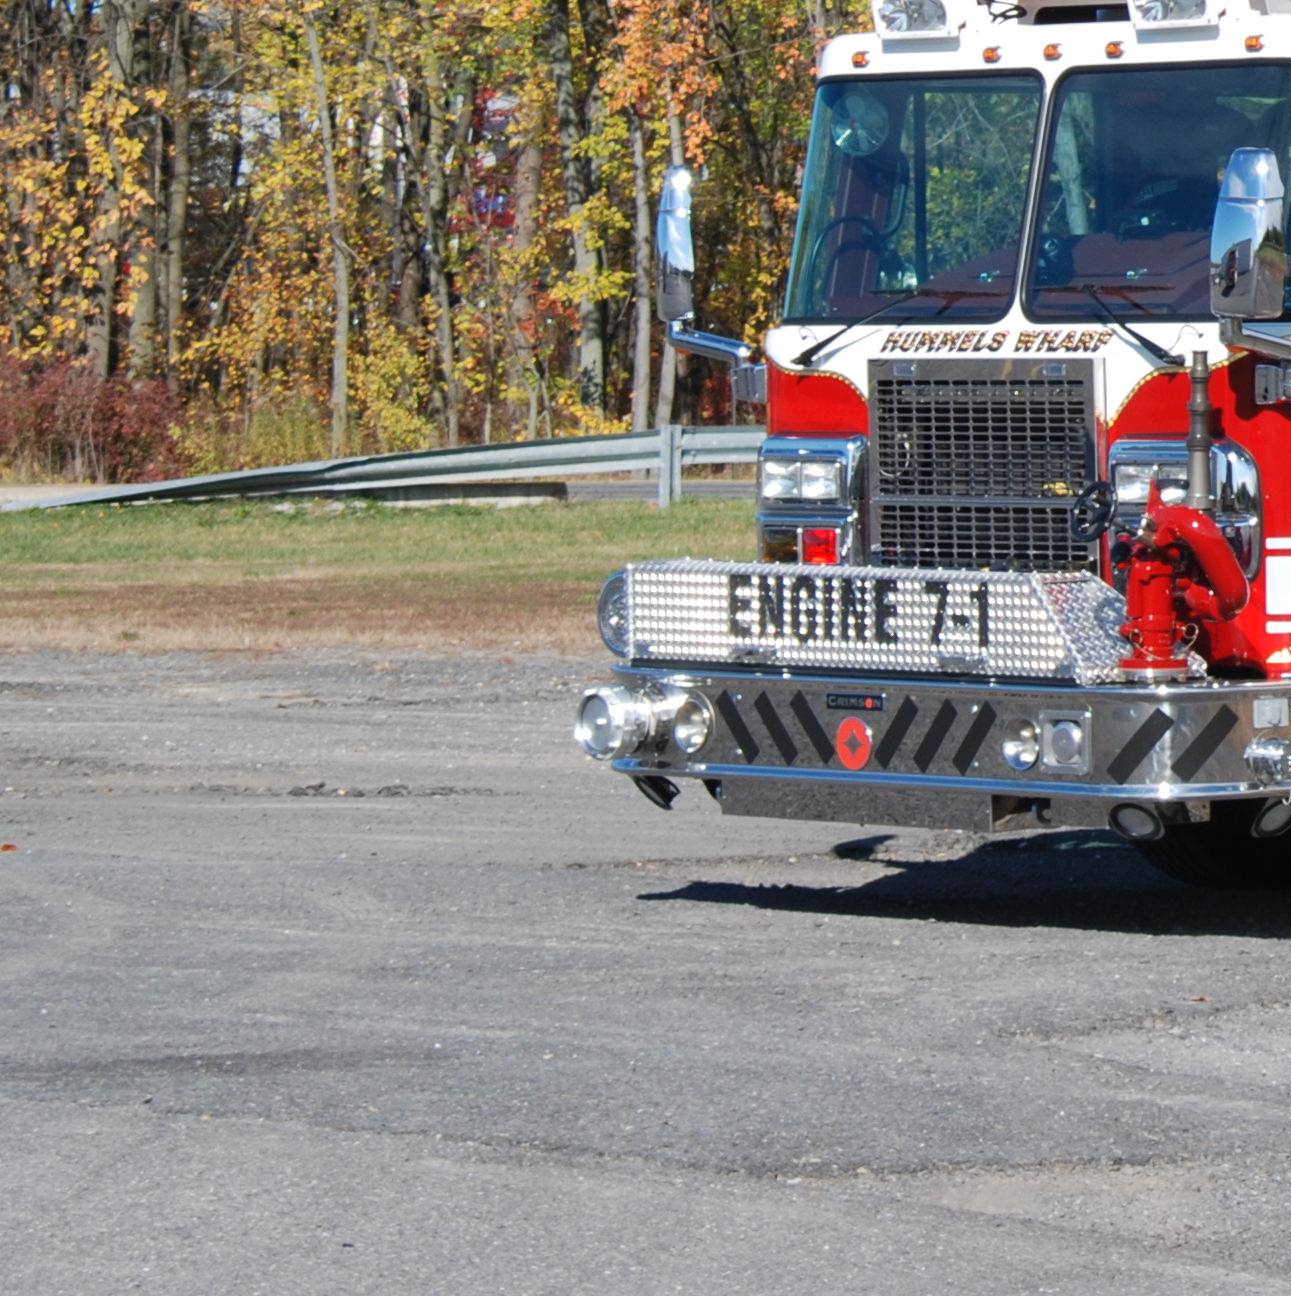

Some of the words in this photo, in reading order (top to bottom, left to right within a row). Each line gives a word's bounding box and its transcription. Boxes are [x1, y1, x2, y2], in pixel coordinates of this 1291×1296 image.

[880, 330, 1009, 353] HUMMELS
[1014, 330, 1114, 353] WHARF
[728, 575, 898, 644] ENGINE
[924, 581, 989, 647] 7-1
